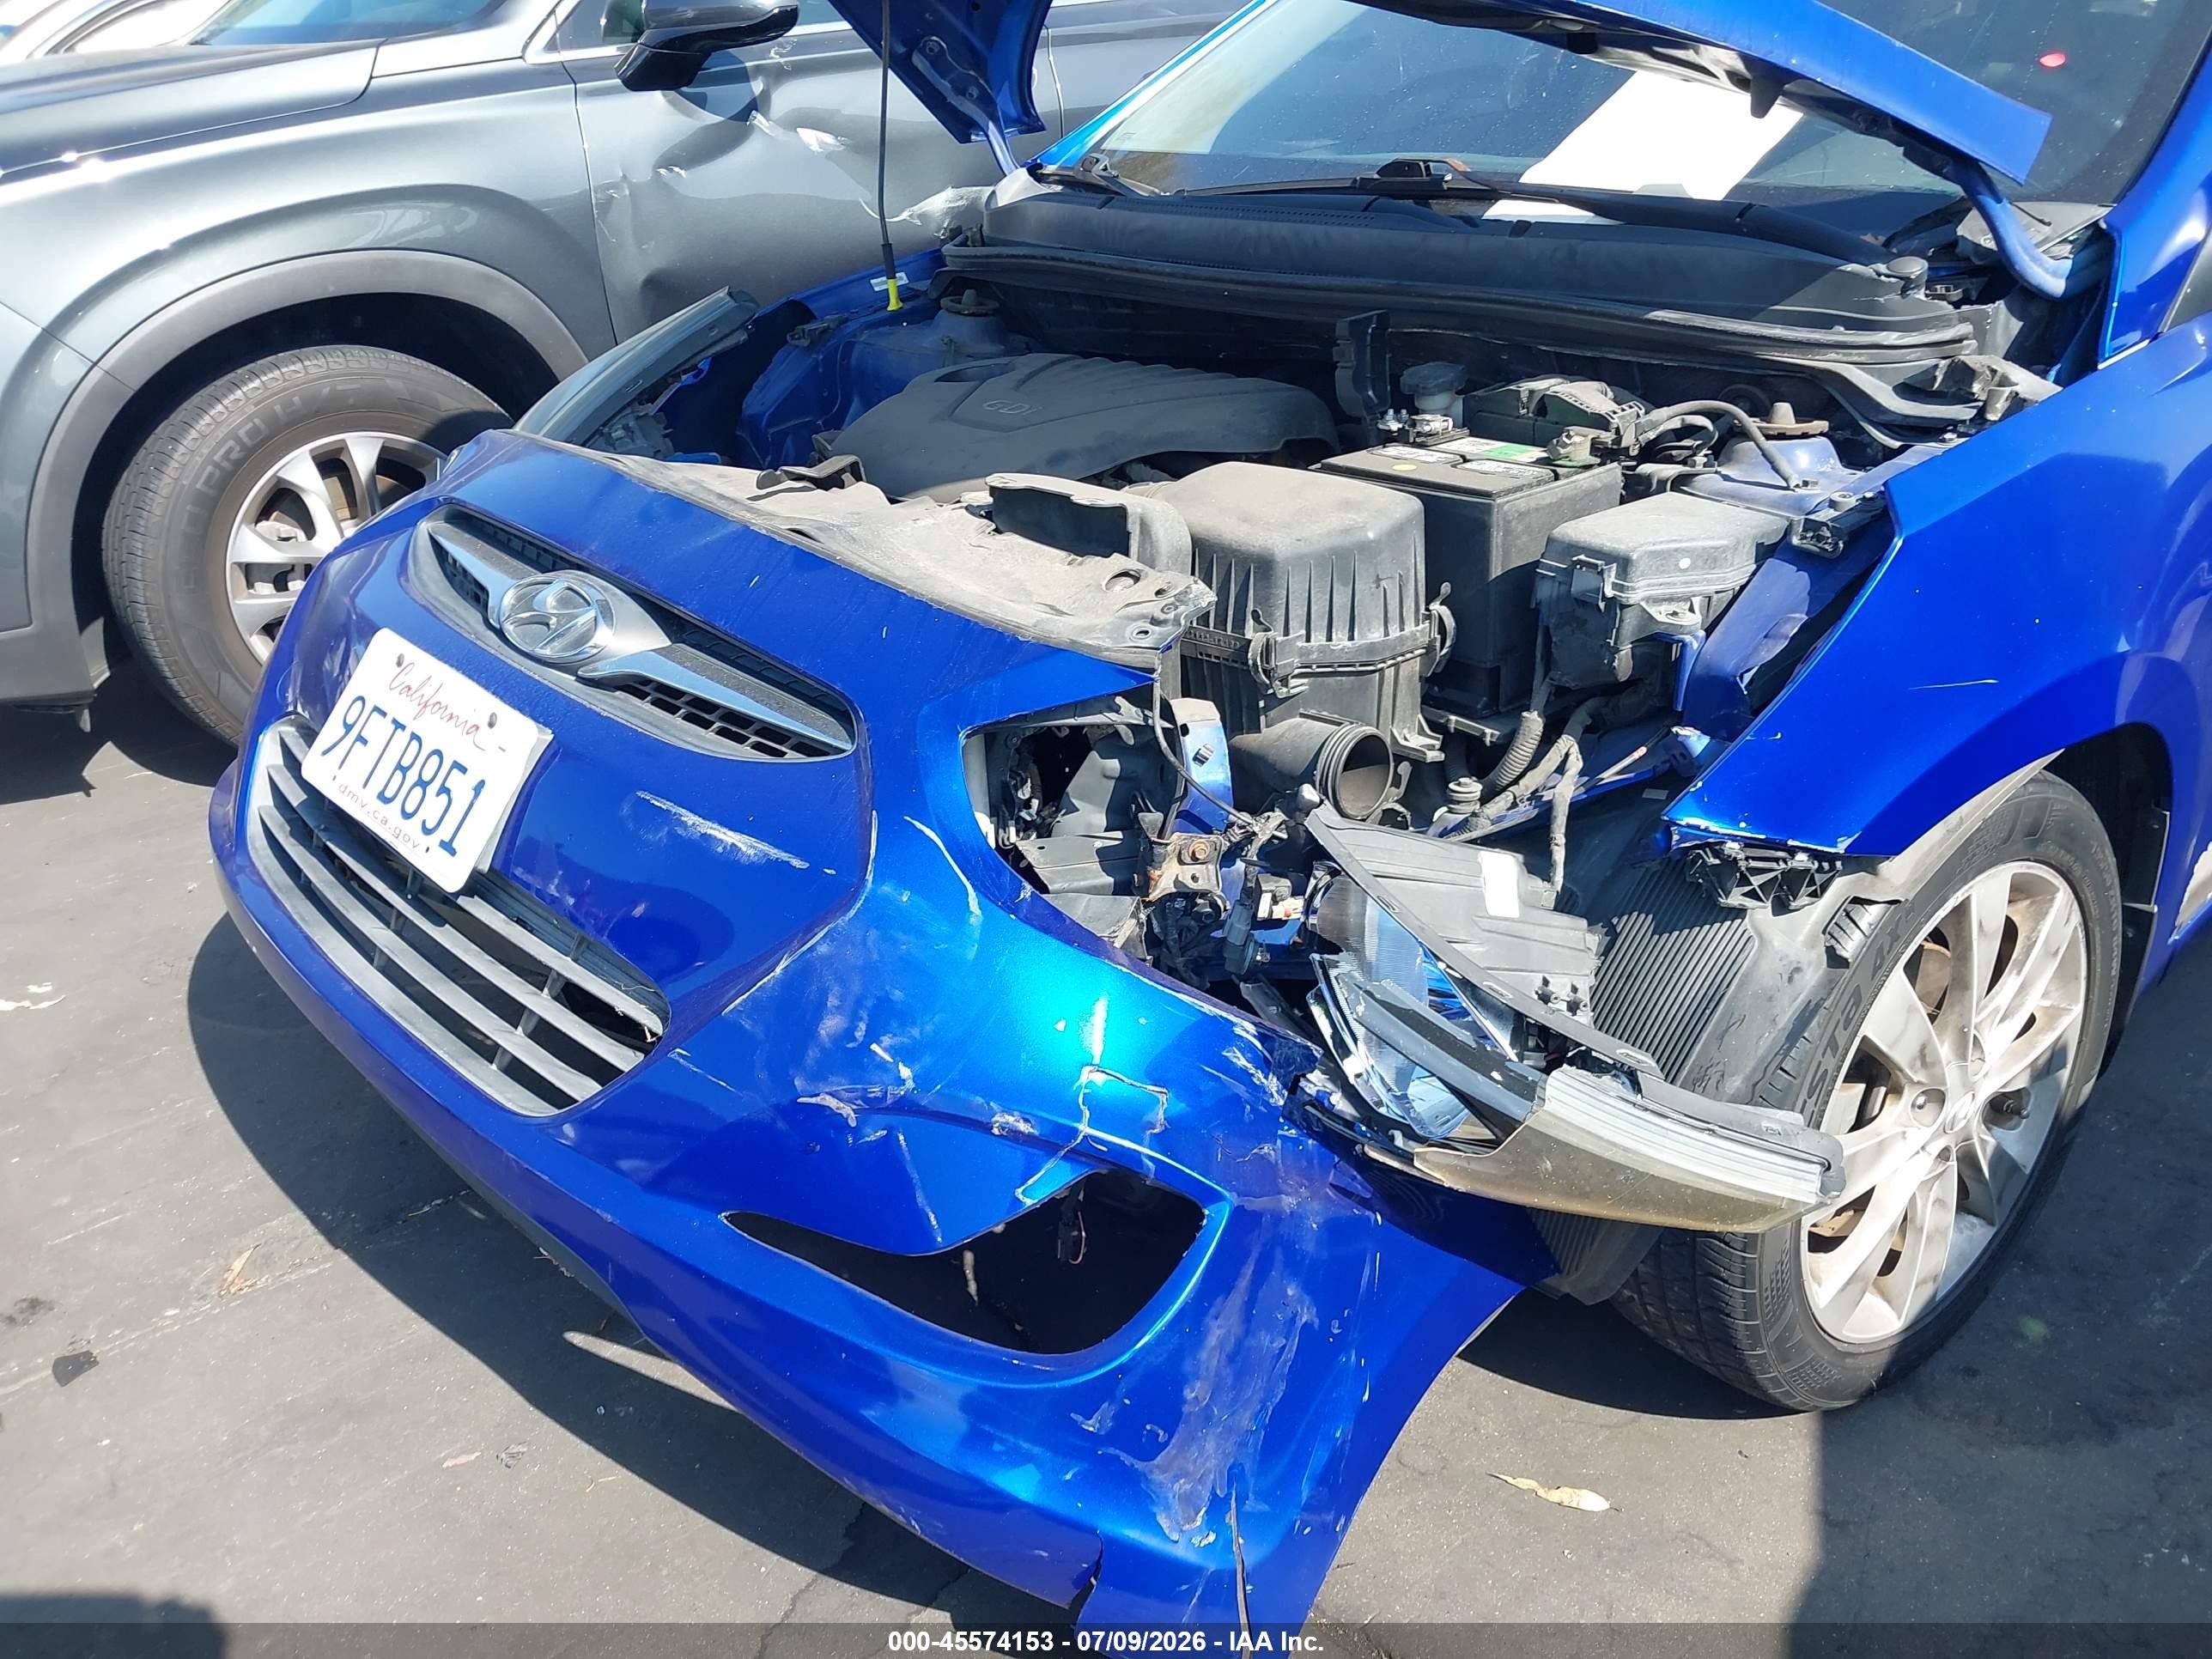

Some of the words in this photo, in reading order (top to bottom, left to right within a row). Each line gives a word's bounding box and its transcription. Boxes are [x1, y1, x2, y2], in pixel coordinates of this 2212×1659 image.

[389, 662, 486, 751] California
[320, 695, 486, 857] 9FTB851
[337, 781, 421, 850] dmv.ca.gov
